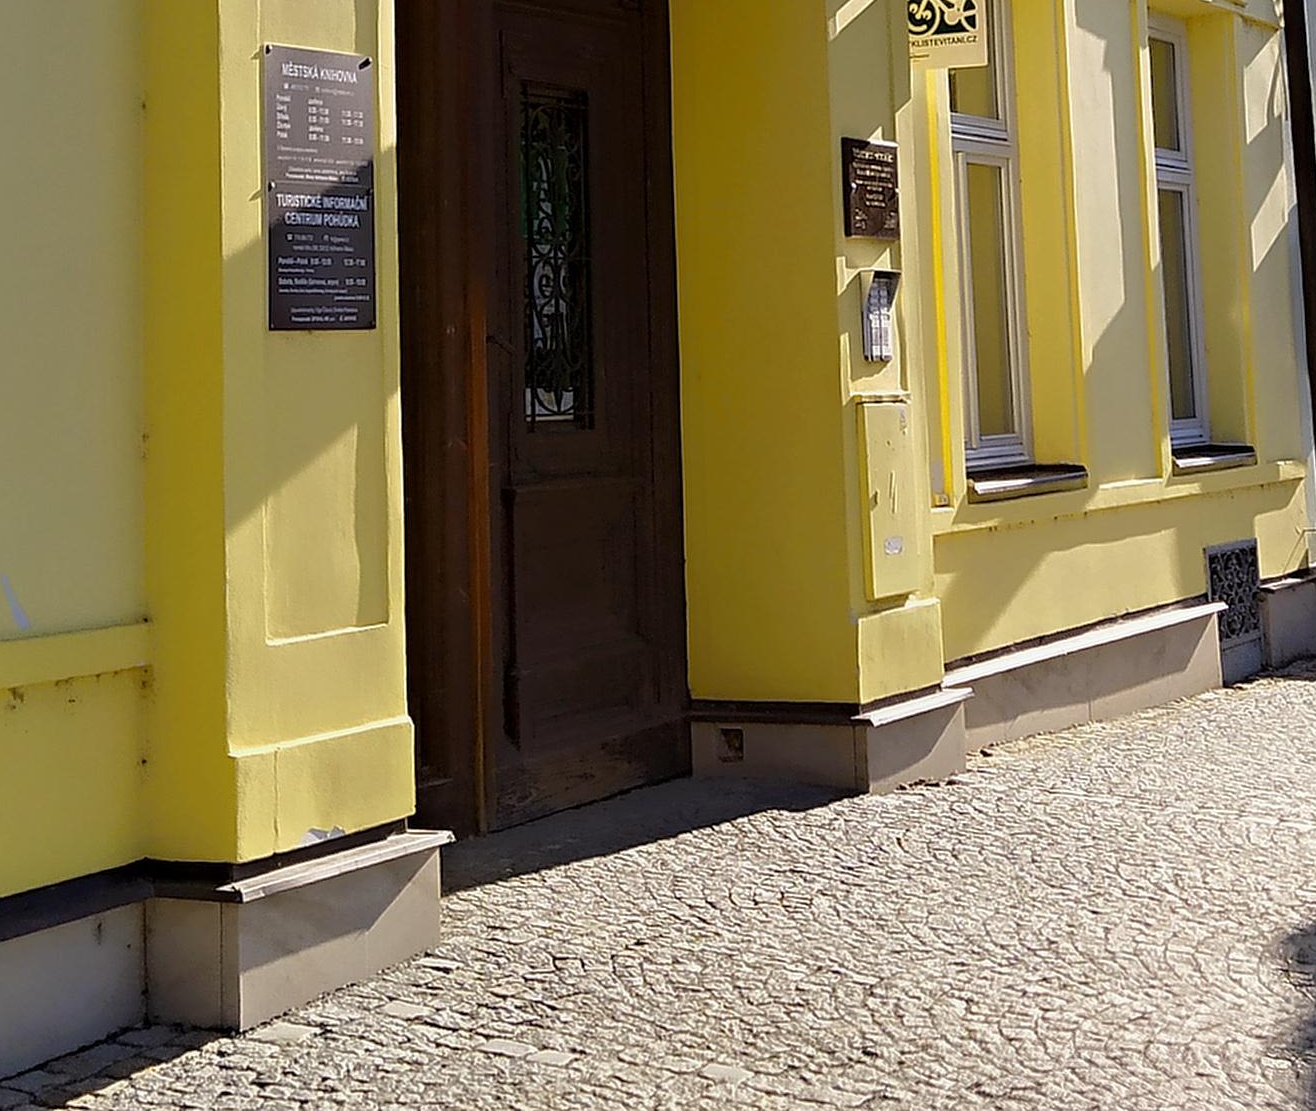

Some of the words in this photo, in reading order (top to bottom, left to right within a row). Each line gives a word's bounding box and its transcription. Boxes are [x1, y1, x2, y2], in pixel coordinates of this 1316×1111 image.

[909, 35, 977, 47] KLISTEVITANI.CZ
[281, 60, 319, 79] MĚSTSKÁ
[320, 68, 358, 84] KNIHOVNA
[276, 192, 322, 208] TURISTICKÉ
[322, 194, 368, 211] INFORMAČNÍ
[284, 211, 323, 226] CENTRUM
